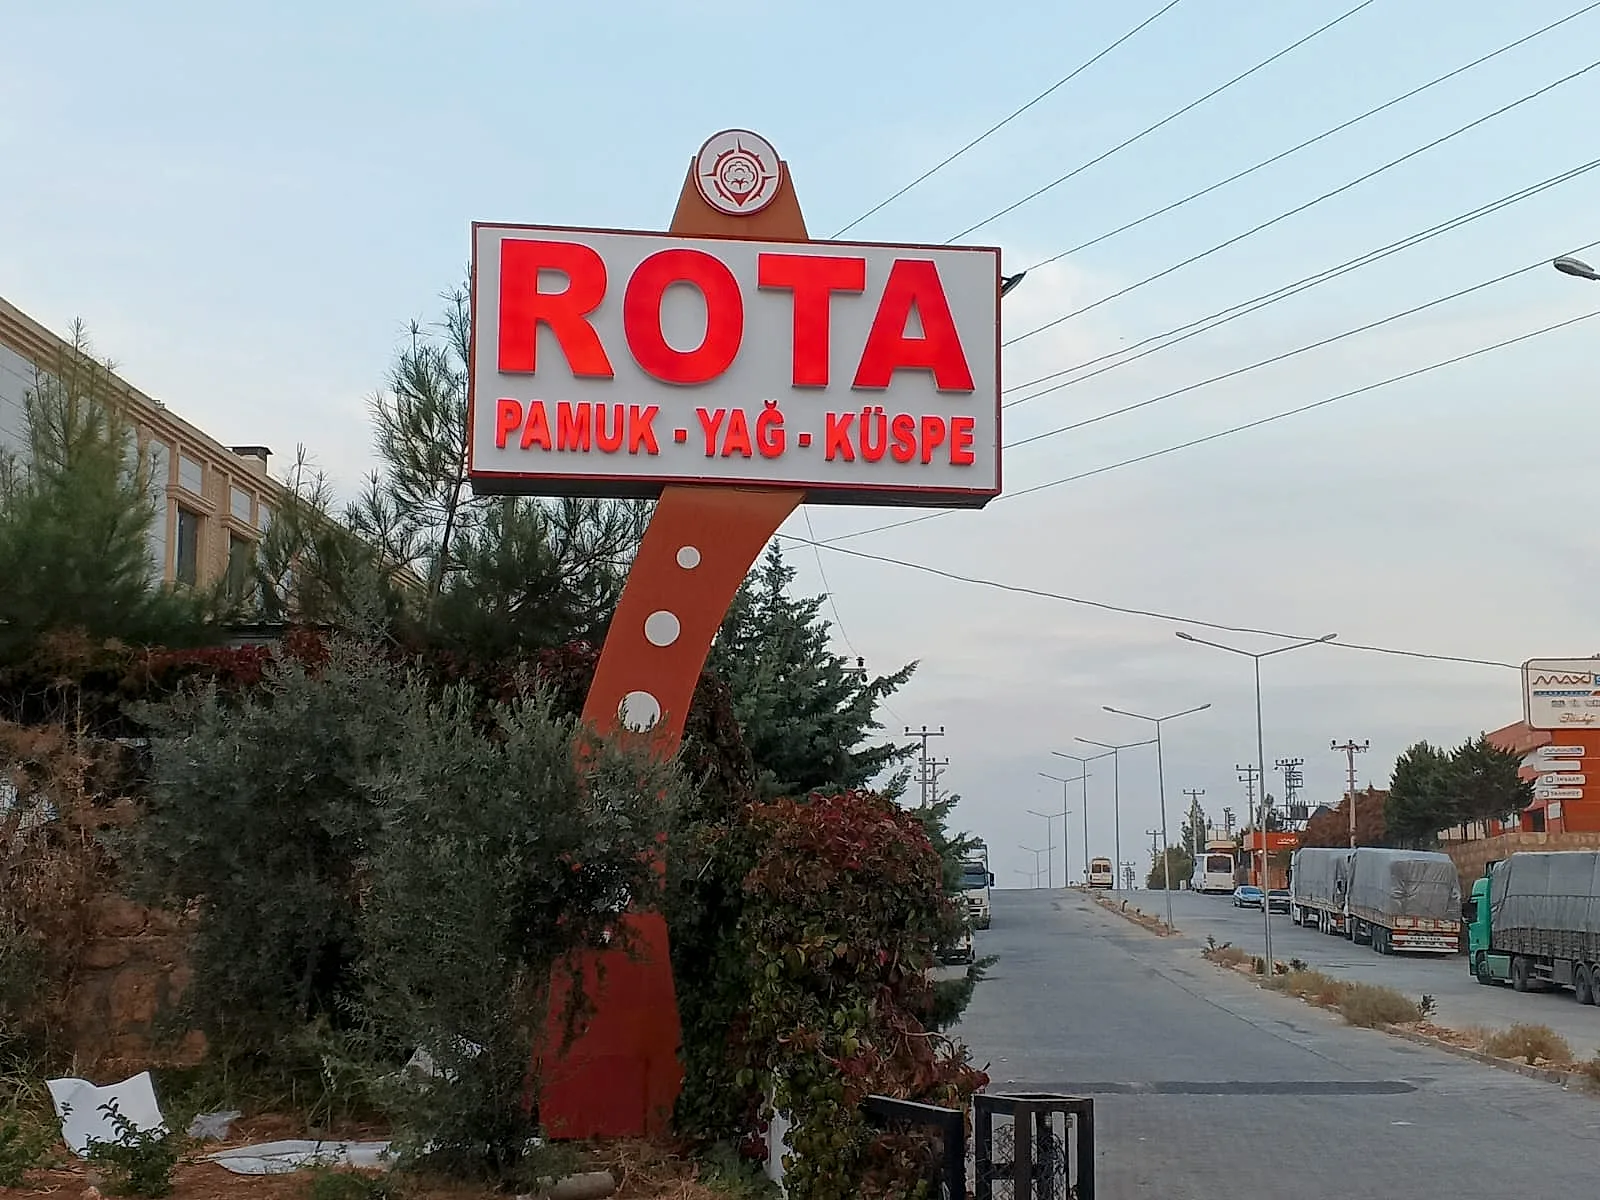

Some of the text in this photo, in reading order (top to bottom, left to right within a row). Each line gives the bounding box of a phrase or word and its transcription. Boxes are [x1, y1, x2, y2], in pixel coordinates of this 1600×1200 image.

[498, 239, 975, 393] ROTA
[495, 398, 975, 465] PAMUK YAĞ KÜSPE
